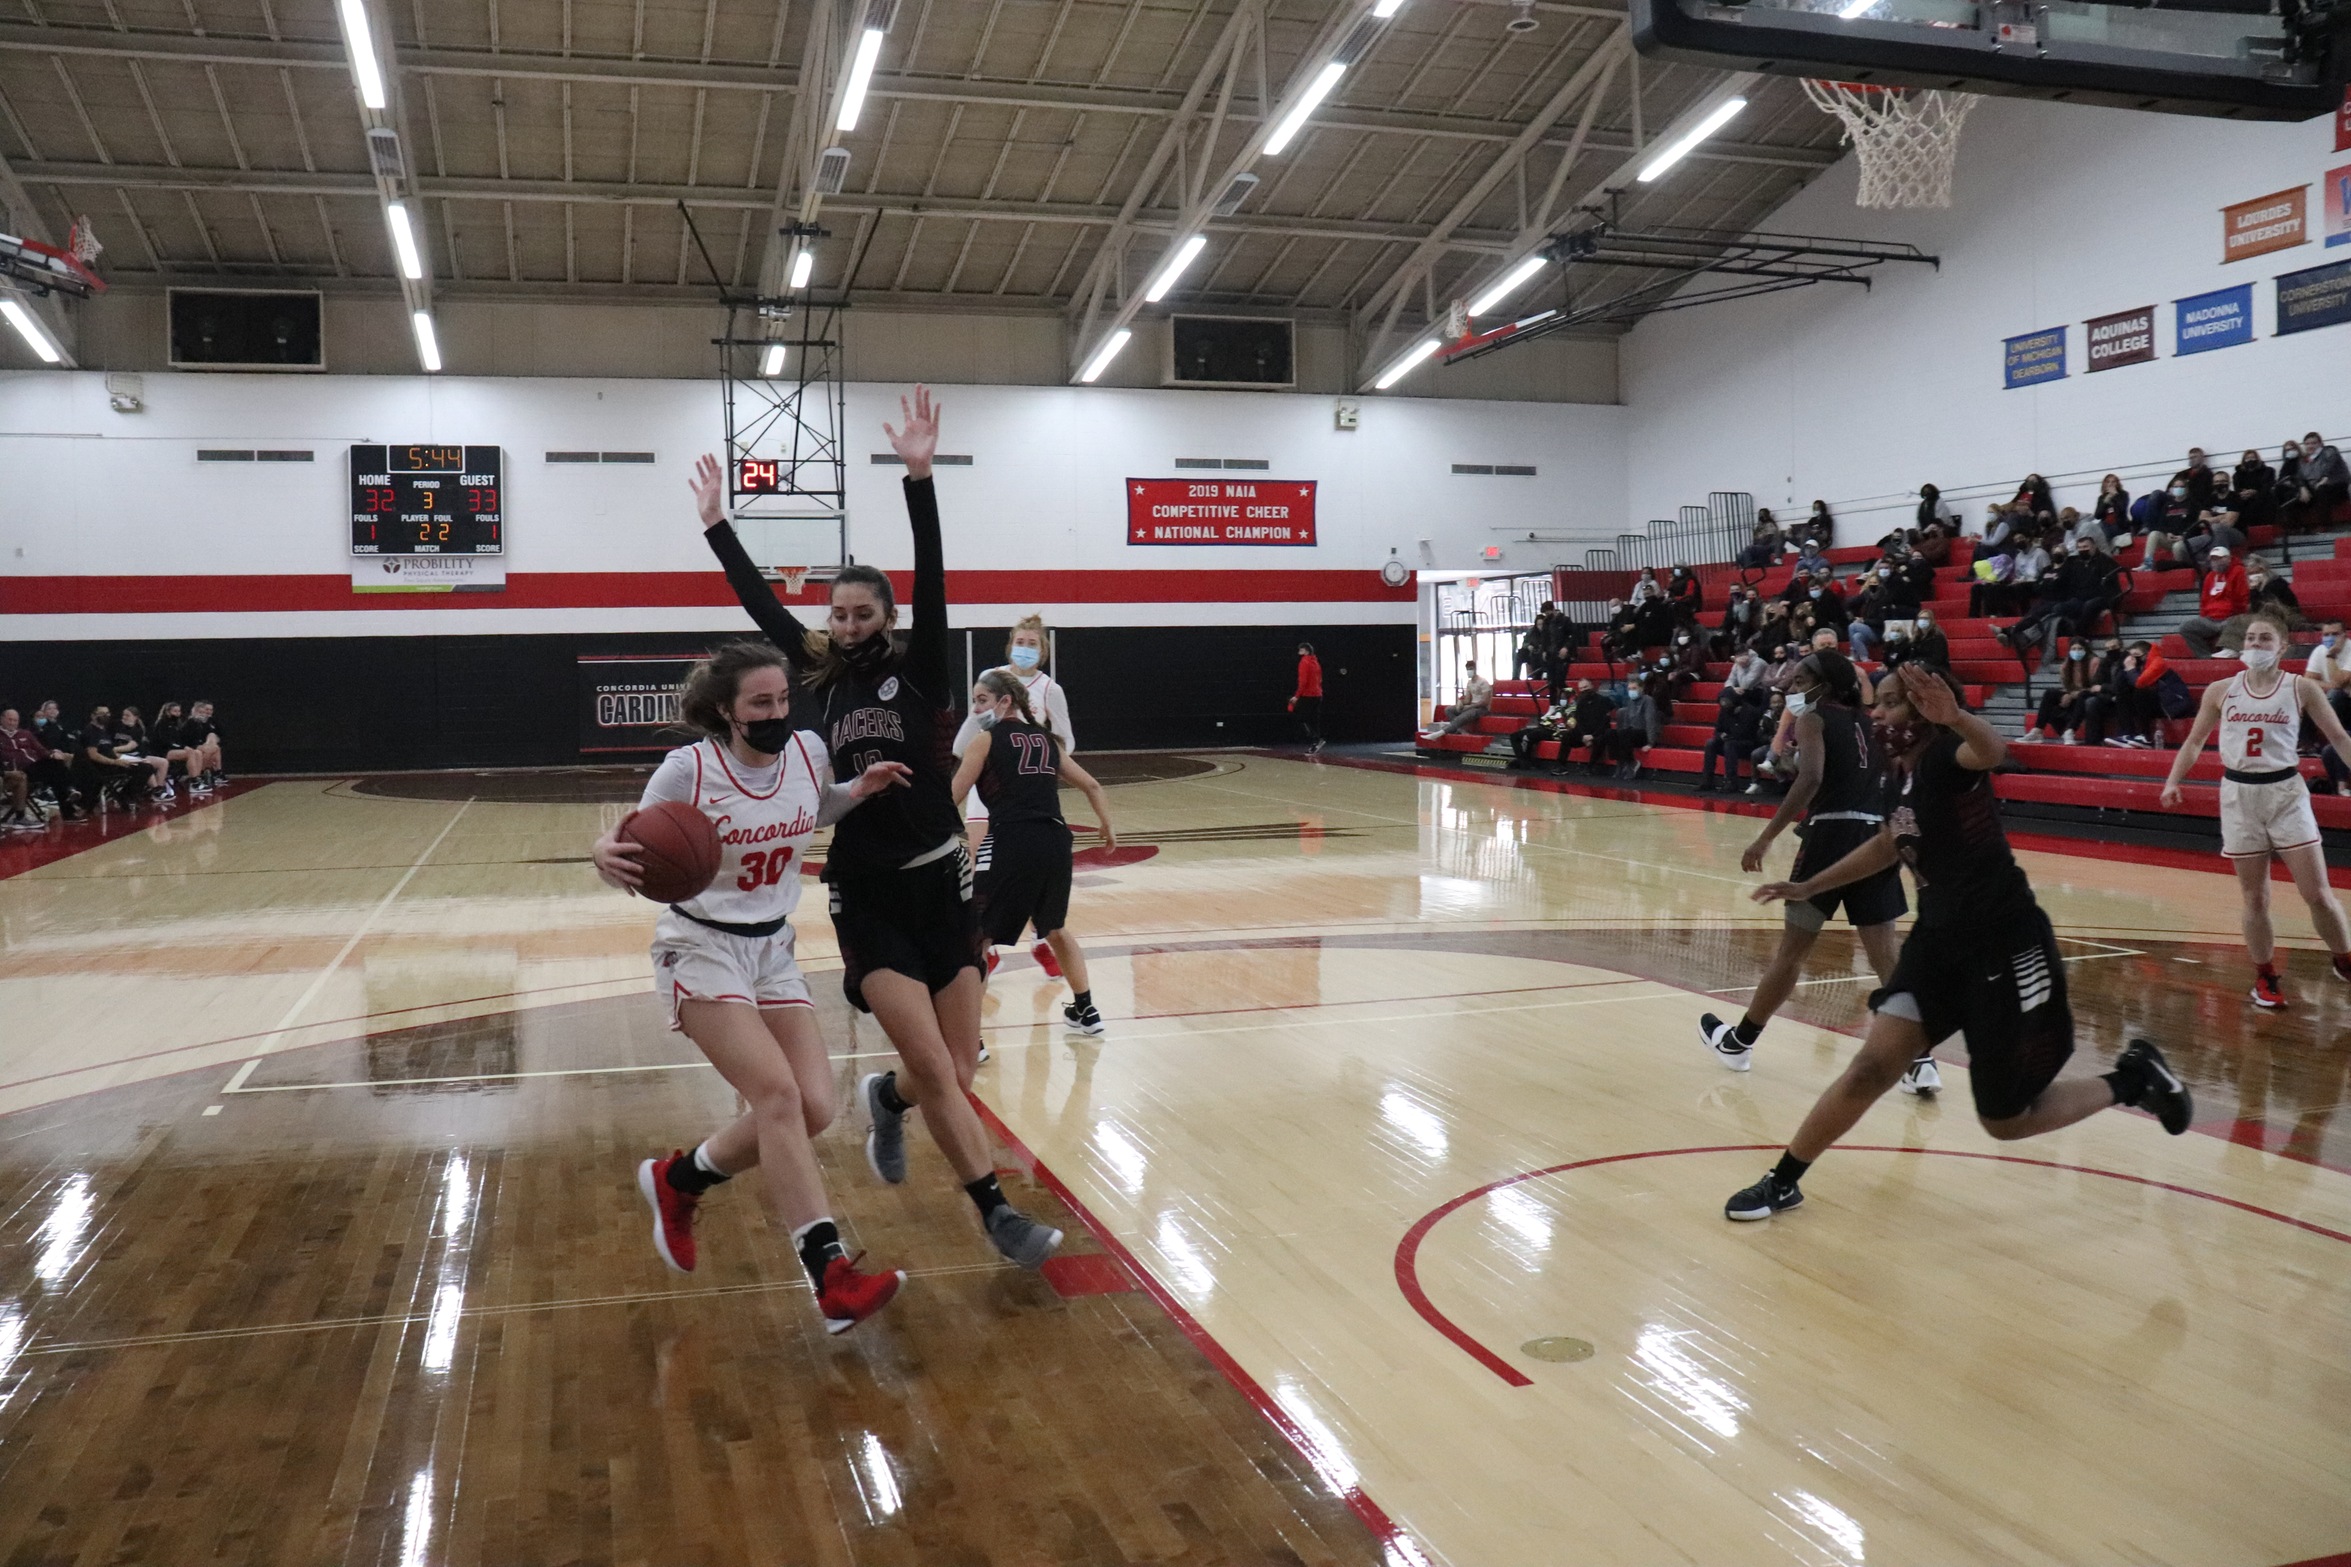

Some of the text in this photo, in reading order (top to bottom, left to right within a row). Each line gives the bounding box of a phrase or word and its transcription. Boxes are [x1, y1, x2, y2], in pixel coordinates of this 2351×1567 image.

[2237, 203, 2292, 229] LOURDES
[2229, 218, 2301, 248] UNIVERSITY
[2185, 302, 2240, 324] MADONNA
[2289, 292, 2347, 316] UNIVERSITY
[2091, 316, 2148, 341] AQUINAS
[2182, 316, 2244, 340] UNIVERSITY
[2011, 334, 2059, 353] UNIVERSITY
[2091, 334, 2150, 359] COLLEGE
[2007, 345, 2063, 366] OF MICHIGAN
[2012, 362, 2059, 379] DEARBORN
[409, 447, 461, 470] 5:44
[358, 474, 391, 486] HOME
[413, 481, 440, 489] PERIOD
[459, 474, 495, 487] GUEST
[743, 462, 775, 488] 24
[366, 489, 395, 511] 32
[423, 491, 433, 509] 3
[469, 489, 497, 511] 33
[1188, 485, 1256, 498] 2019 NAIA
[354, 514, 378, 522] FOULS
[401, 514, 453, 522] PLAYER FOUL
[475, 514, 499, 522] FOULS
[1152, 505, 1289, 518] COMPETITIVE CHEER
[1154, 526, 1291, 539] NATIONAL CHAMPION
[354, 545, 379, 553] SCORE
[414, 545, 440, 553] MATCH
[475, 545, 500, 553] SCORE
[403, 557, 475, 571] PROBILITY
[596, 684, 657, 692] CONCORDIA
[2226, 705, 2291, 725] Concordia
[831, 707, 905, 755] RACERS
[2246, 727, 2264, 757] 2
[1010, 733, 1056, 775] 22
[715, 805, 815, 845] Concordia
[737, 846, 794, 892] 30
